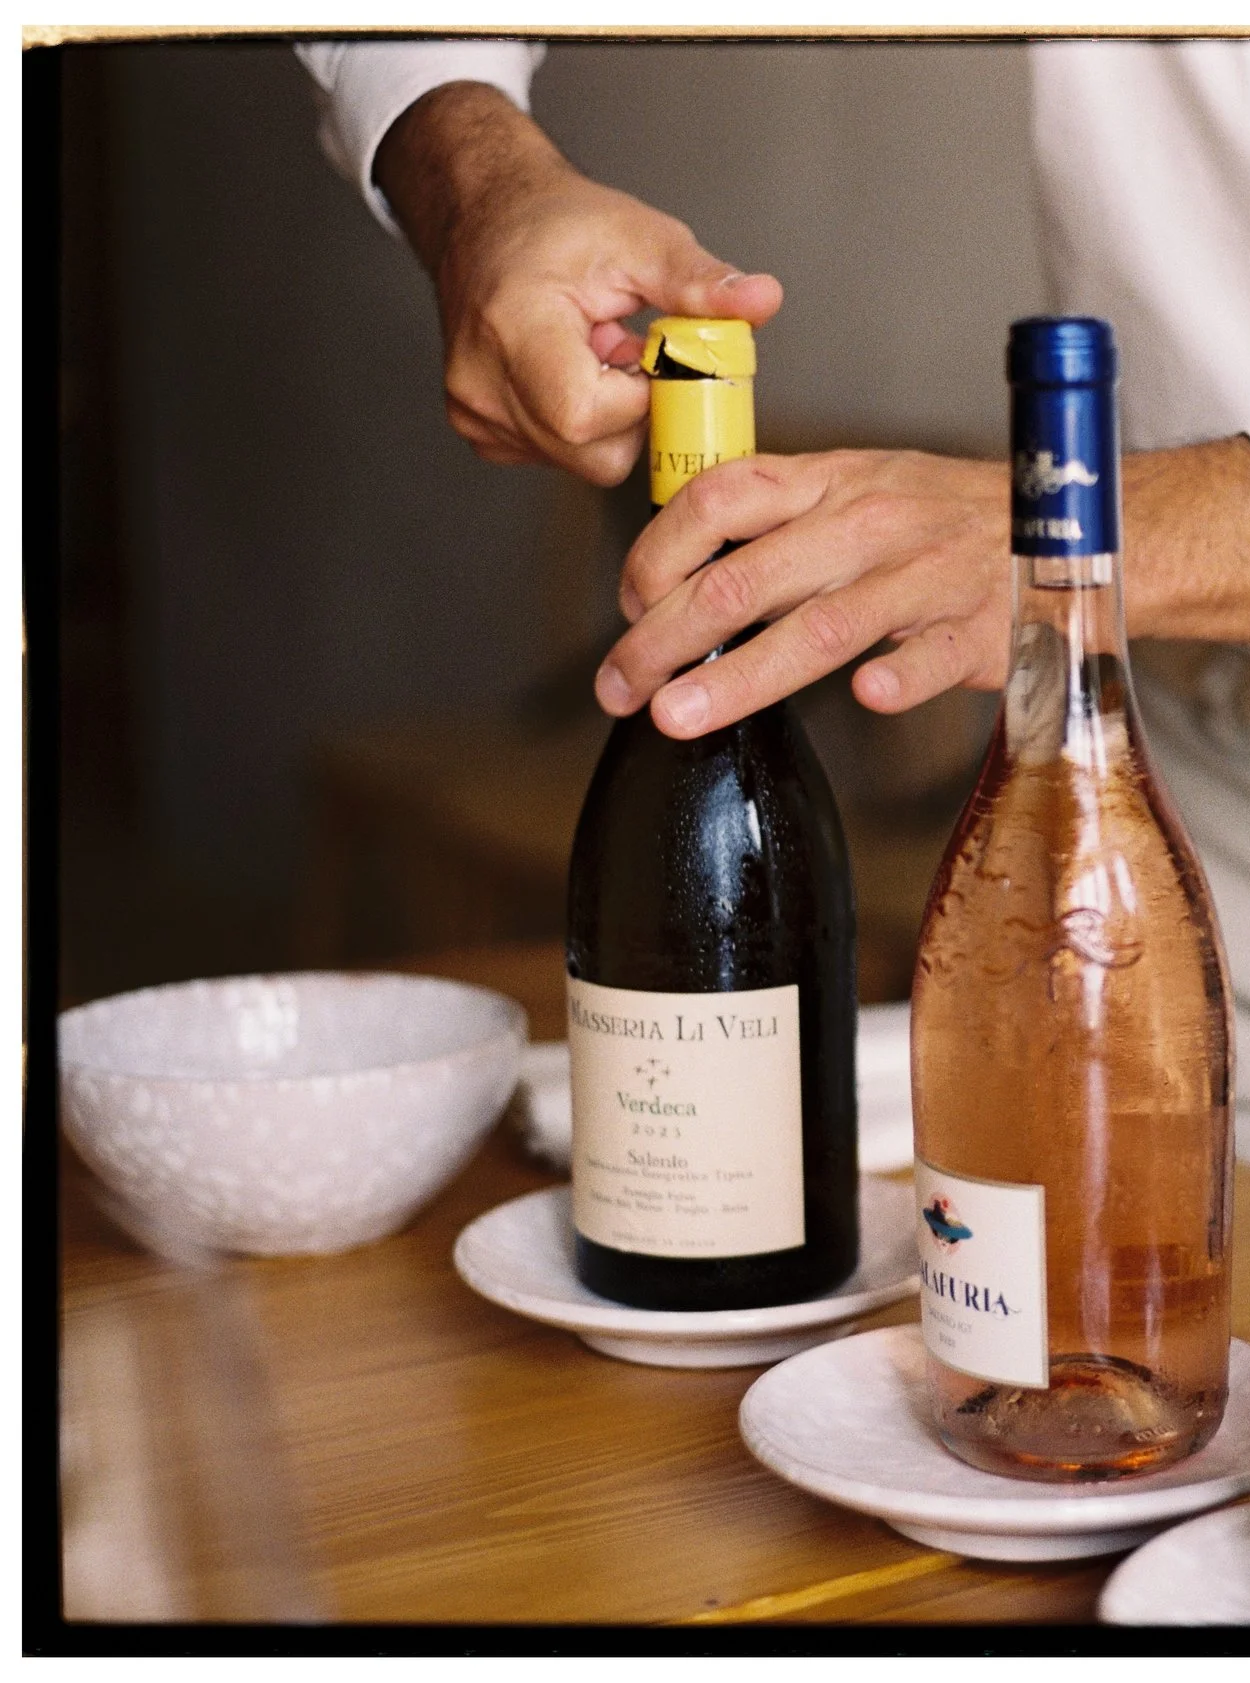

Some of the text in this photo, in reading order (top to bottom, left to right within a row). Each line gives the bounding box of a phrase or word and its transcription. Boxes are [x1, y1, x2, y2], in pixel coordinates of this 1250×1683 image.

[571, 1000, 664, 1040] MASSERIA
[617, 1091, 698, 1117] Verdeca
[627, 1151, 689, 1169] Salento
